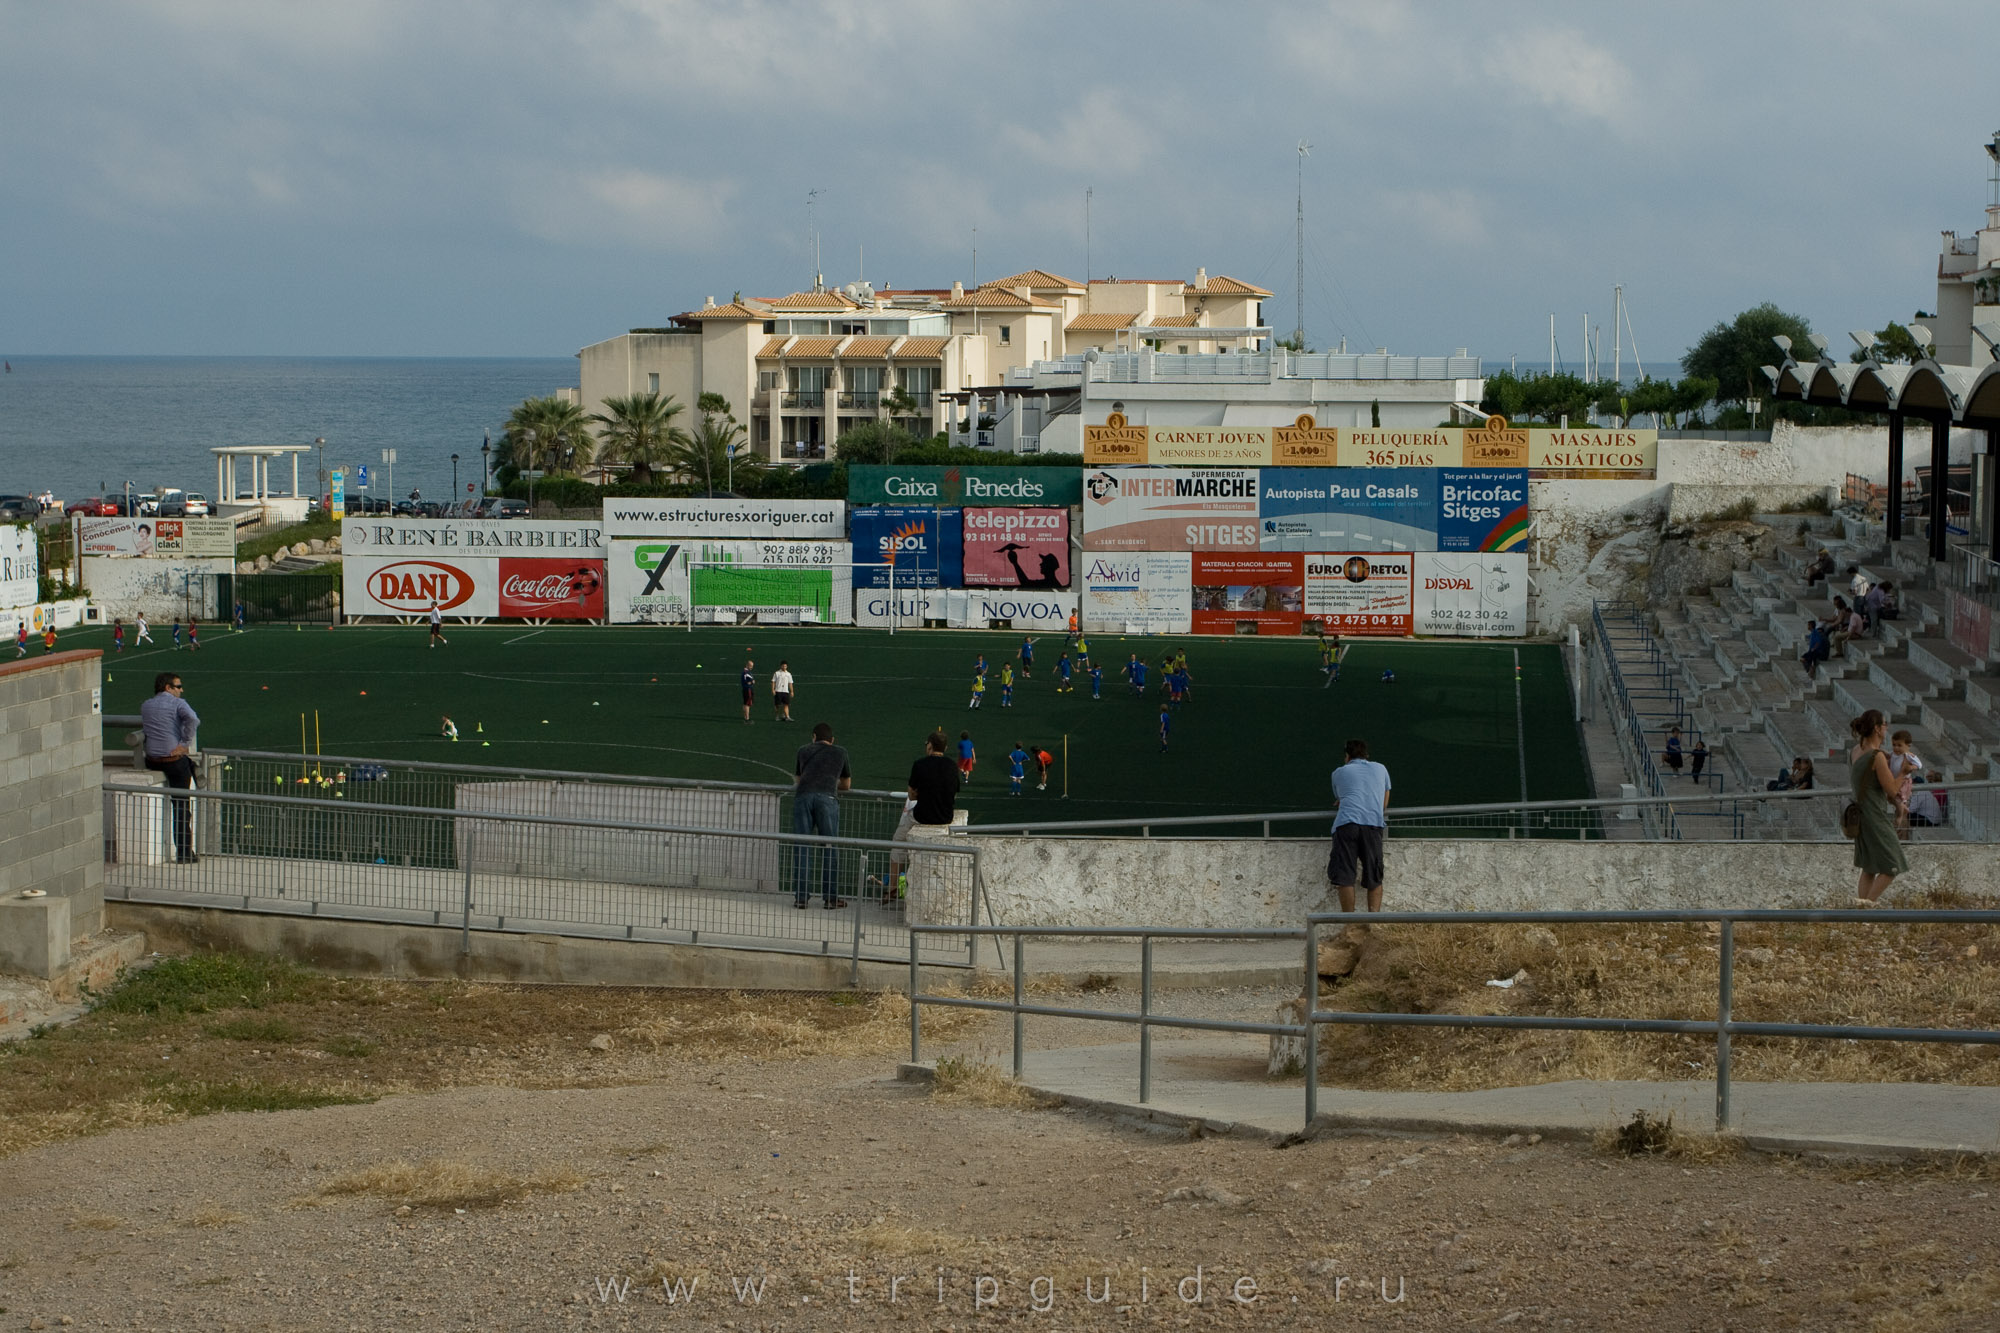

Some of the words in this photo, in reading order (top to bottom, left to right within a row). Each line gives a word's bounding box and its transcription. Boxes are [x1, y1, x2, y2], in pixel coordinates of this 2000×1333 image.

[1088, 429, 1146, 441] MASAJES
[1155, 432, 1214, 444] CARNET
[1218, 432, 1266, 445] JOVEN
[1277, 430, 1335, 443] MASAJES
[1352, 430, 1449, 447] PELUQUERÍA
[1467, 432, 1526, 445] MASAJES
[1550, 433, 1636, 447] MASAJES
[1101, 444, 1131, 453] 1.000
[1159, 449, 1207, 458] MENORES
[1208, 450, 1221, 458] DE
[1223, 450, 1233, 458] 25
[1235, 448, 1262, 459] AÑOS
[1289, 446, 1320, 455] 1.000
[1480, 448, 1511, 457] 1.000
[1366, 450, 1395, 466] 365
[1399, 450, 1434, 466] DÍAS
[1541, 450, 1644, 466] ASIÁTICOS
[884, 476, 938, 497] Caixa
[965, 477, 1044, 498] Penedès
[1265, 488, 1326, 501] Autopista
[1330, 485, 1360, 499] Pau
[1365, 484, 1419, 499] Casals
[1443, 485, 1522, 501] Bricofac
[613, 508, 835, 527] www.estructuresxoriguer.cat
[1443, 502, 1501, 522] Sitges
[158, 522, 180, 532] click
[965, 511, 1060, 532] telepizza
[371, 525, 458, 547] RENÉ
[466, 528, 603, 548] BARBIER
[966, 533, 977, 542] 93
[980, 533, 997, 542] 811
[1000, 533, 1012, 542] 48
[1015, 533, 1026, 542] 48
[1185, 524, 1256, 546] SITGES
[157, 539, 181, 549] clack
[879, 536, 927, 550] SISOL
[763, 545, 785, 555] 902
[789, 545, 811, 555] 889
[814, 546, 833, 555] 961
[762, 555, 783, 563] 615
[1307, 564, 1343, 575] EURO
[1370, 564, 1408, 575] RETOL
[379, 573, 450, 600] DANI
[1424, 577, 1474, 590] DISVAL
[633, 595, 683, 604] ESTRUCTURES
[633, 603, 683, 614] XORIGUER
[868, 599, 930, 617] GRUP
[982, 601, 1064, 620] NOVOA
[1430, 609, 1453, 619] 902
[1456, 610, 1472, 619] 42
[1474, 610, 1490, 620] 30
[1493, 610, 1509, 620] 42
[1325, 615, 1341, 625] 93
[1344, 615, 1368, 625] 475
[1371, 615, 1387, 625] 04
[1391, 615, 1405, 625] 21
[1424, 622, 1515, 632] www.disval.com
